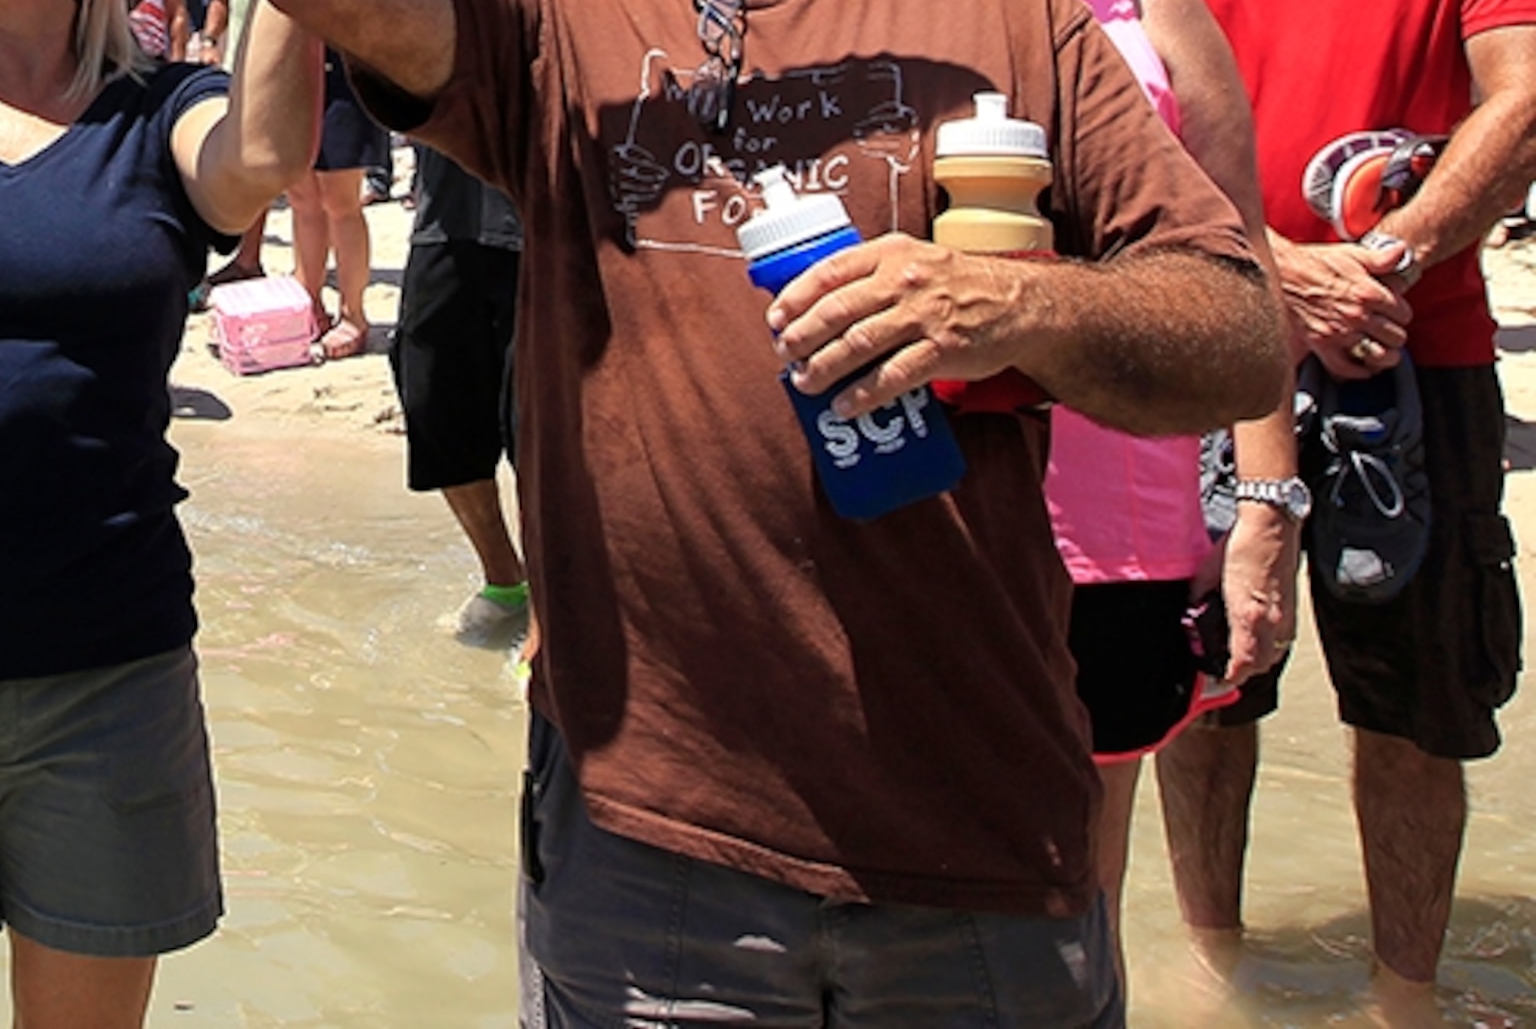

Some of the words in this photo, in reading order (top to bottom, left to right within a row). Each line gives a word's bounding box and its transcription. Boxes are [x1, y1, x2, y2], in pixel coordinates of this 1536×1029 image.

[746, 92, 842, 124] Work
[732, 127, 779, 153] for
[673, 140, 850, 192] ORGNIC
